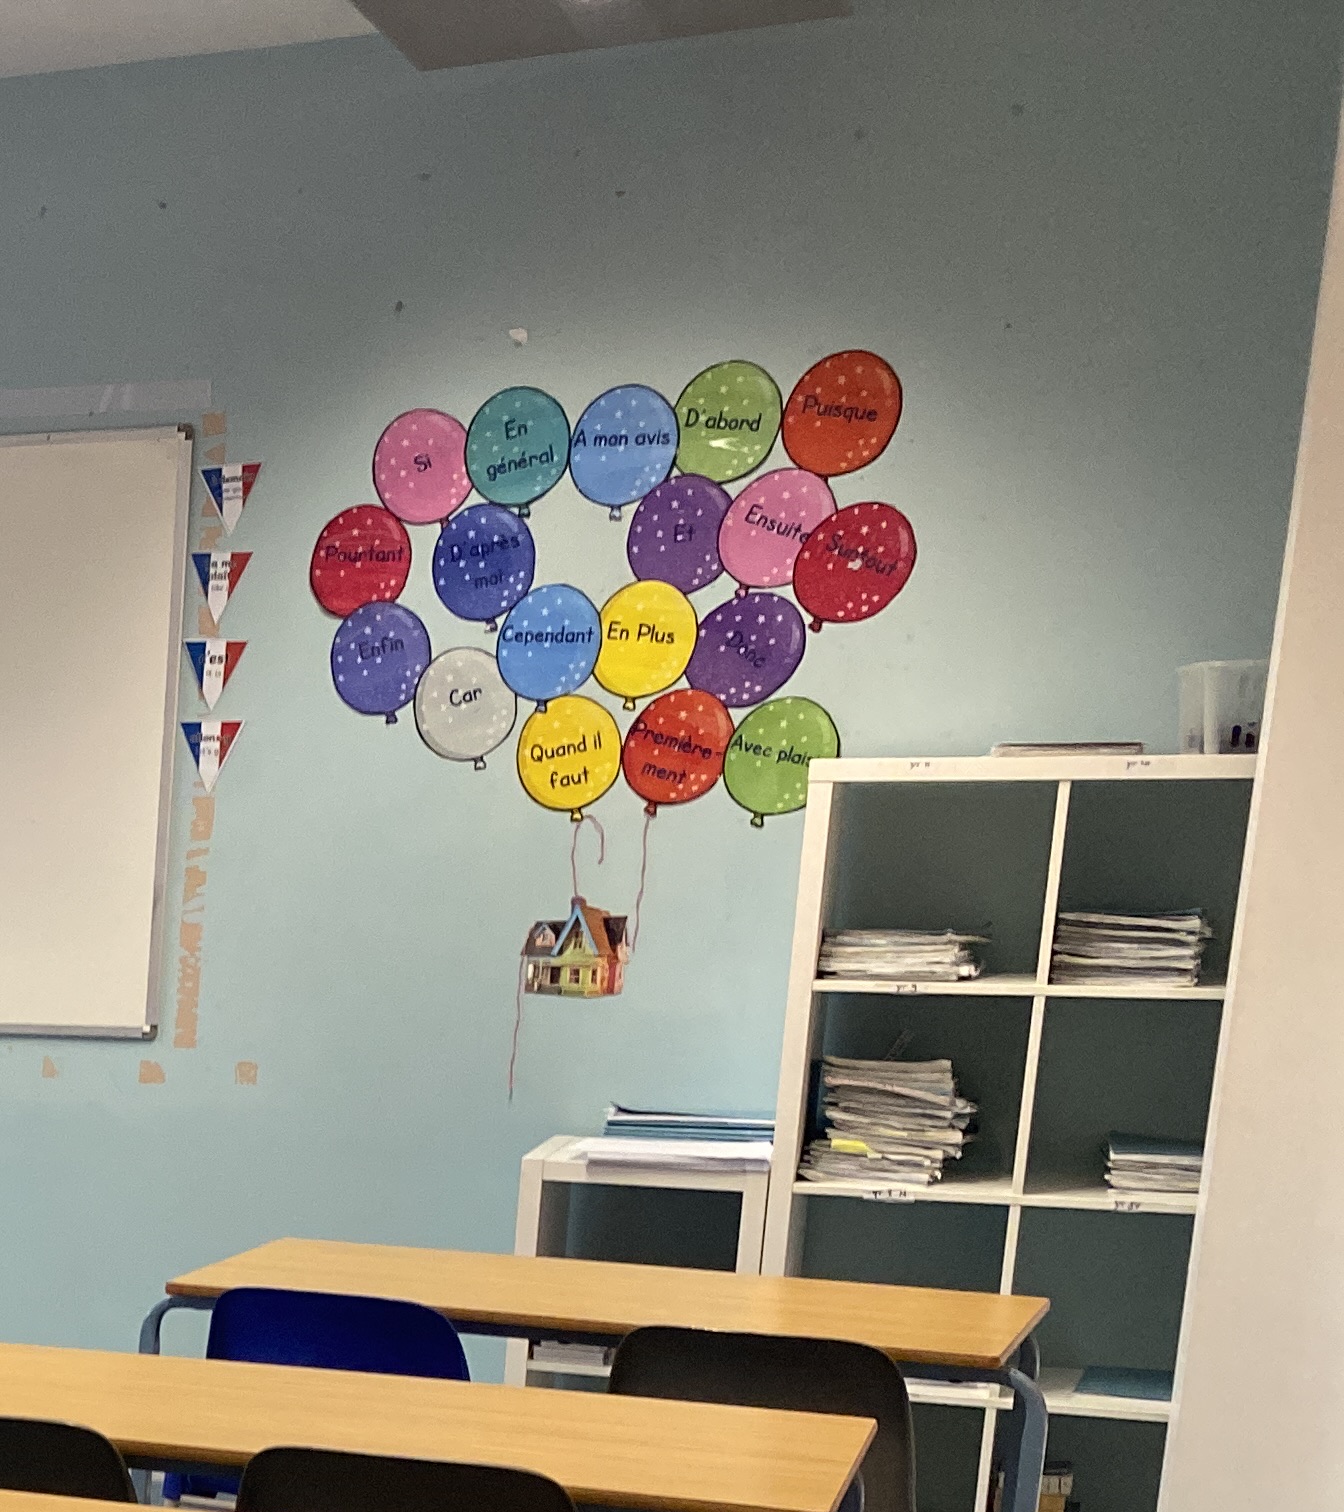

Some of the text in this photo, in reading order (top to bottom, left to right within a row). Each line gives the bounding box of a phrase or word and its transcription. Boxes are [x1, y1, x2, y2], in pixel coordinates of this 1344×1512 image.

[684, 407, 762, 433] D'abord
[800, 394, 879, 422] Puisque
[504, 419, 528, 441] En
[573, 429, 671, 448] A mon avis
[413, 453, 433, 473] Si
[485, 444, 556, 481] général
[673, 522, 696, 544] Et
[744, 503, 811, 544] Ensuite
[324, 544, 405, 563] Pourtant
[449, 532, 522, 563] D'après
[473, 570, 504, 589] moi
[501, 625, 595, 647] Cependant
[606, 620, 676, 645] En Plus
[358, 635, 405, 661] Enfin
[724, 629, 767, 668] Donc
[448, 686, 483, 708] Car
[529, 731, 603, 763] Quand il
[730, 734, 773, 758] Avec
[549, 766, 590, 790] faut
[641, 761, 688, 784] ment
